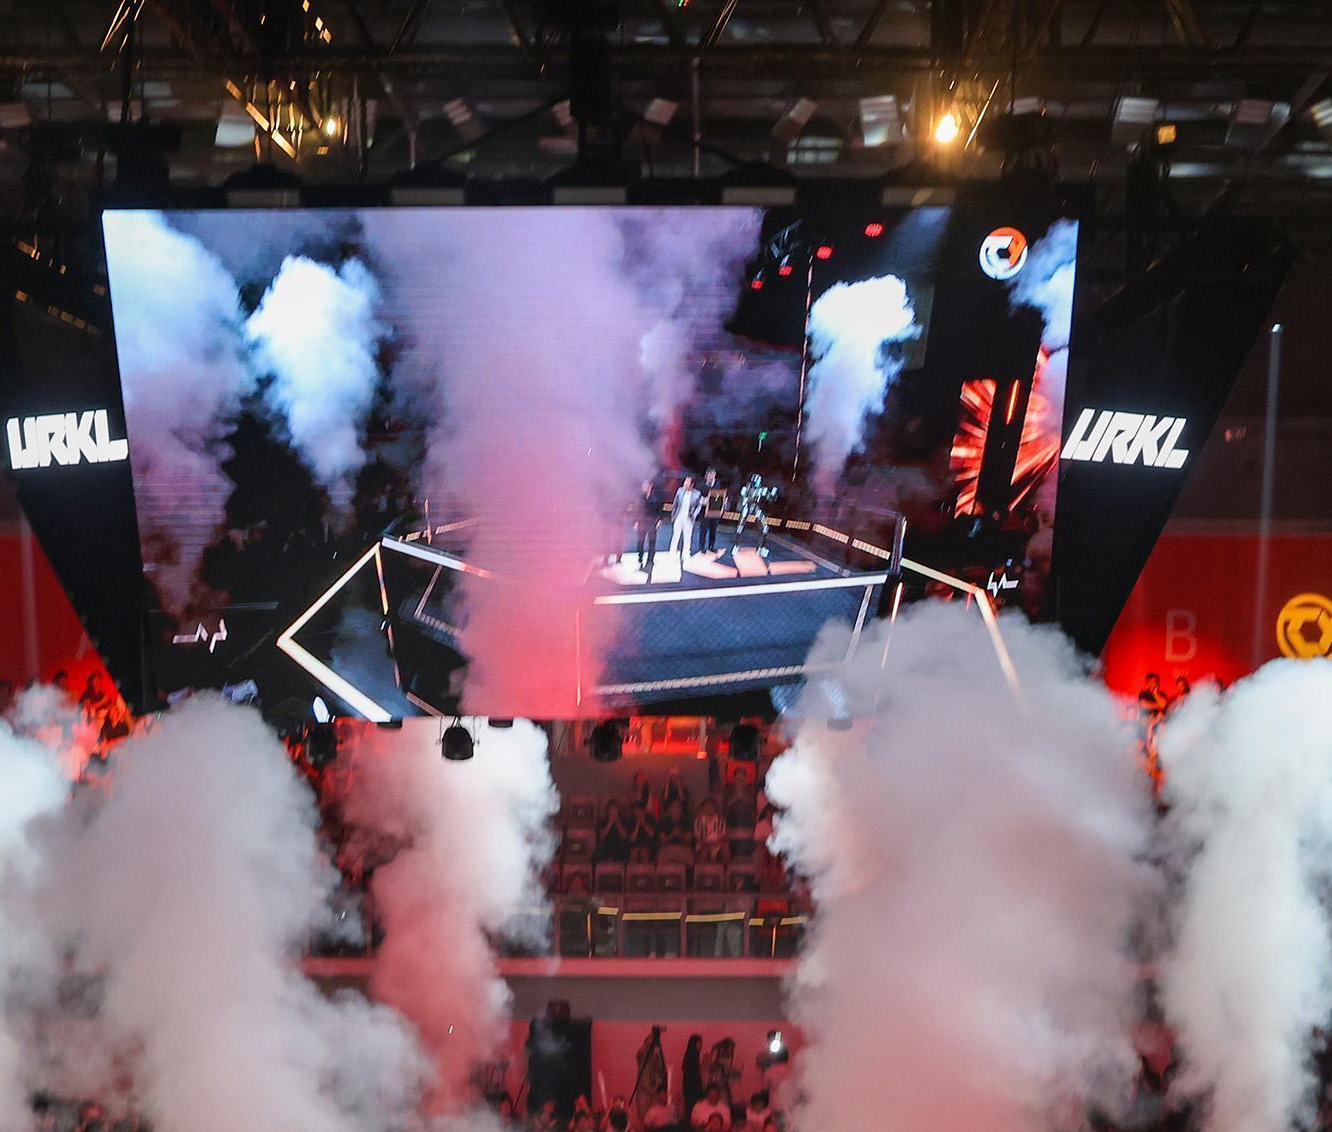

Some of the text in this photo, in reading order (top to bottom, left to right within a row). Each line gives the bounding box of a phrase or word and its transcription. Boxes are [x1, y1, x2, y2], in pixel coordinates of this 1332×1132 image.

[6, 409, 128, 470] URKL
[1060, 408, 1190, 469] URKL
[1166, 608, 1196, 661] B
